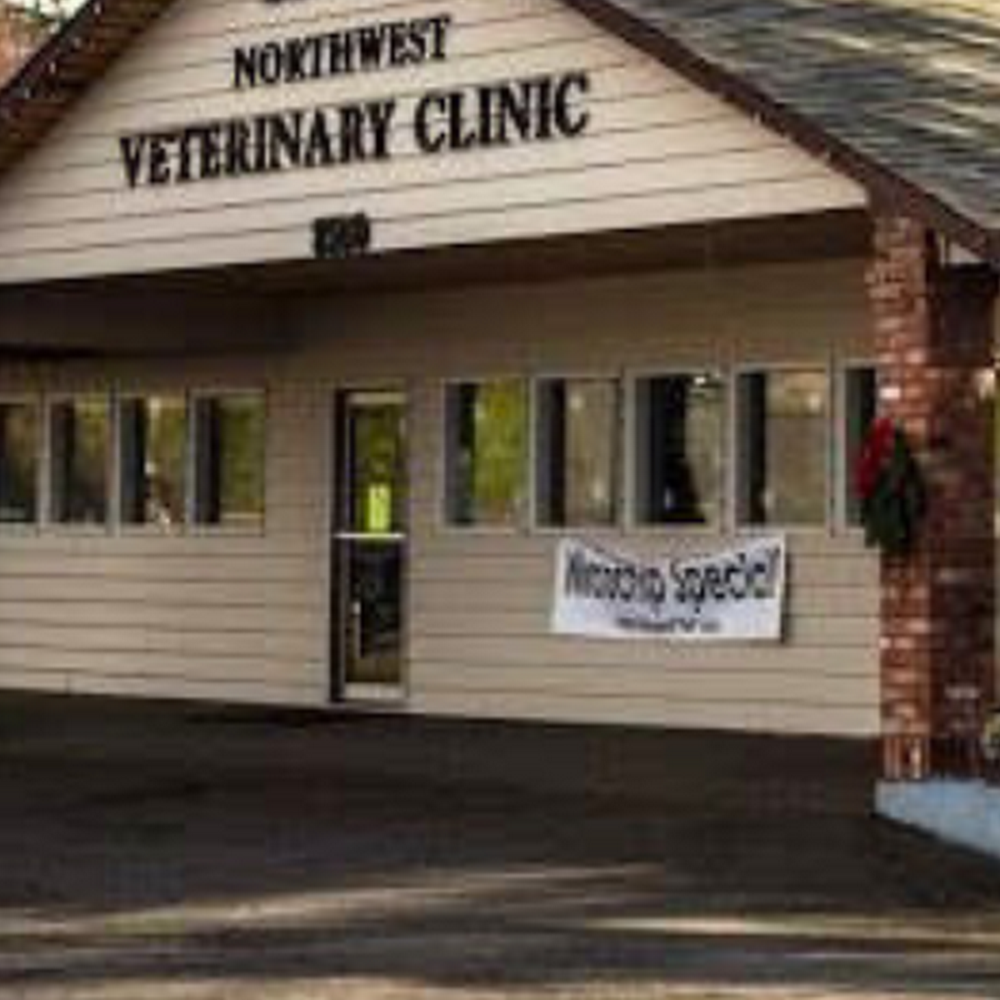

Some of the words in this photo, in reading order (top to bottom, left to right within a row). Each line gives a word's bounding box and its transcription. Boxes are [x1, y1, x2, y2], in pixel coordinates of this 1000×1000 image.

[233, 15, 451, 88] NORTHWEST
[119, 100, 396, 188] VETERINARY
[413, 73, 590, 152] CLINIC
